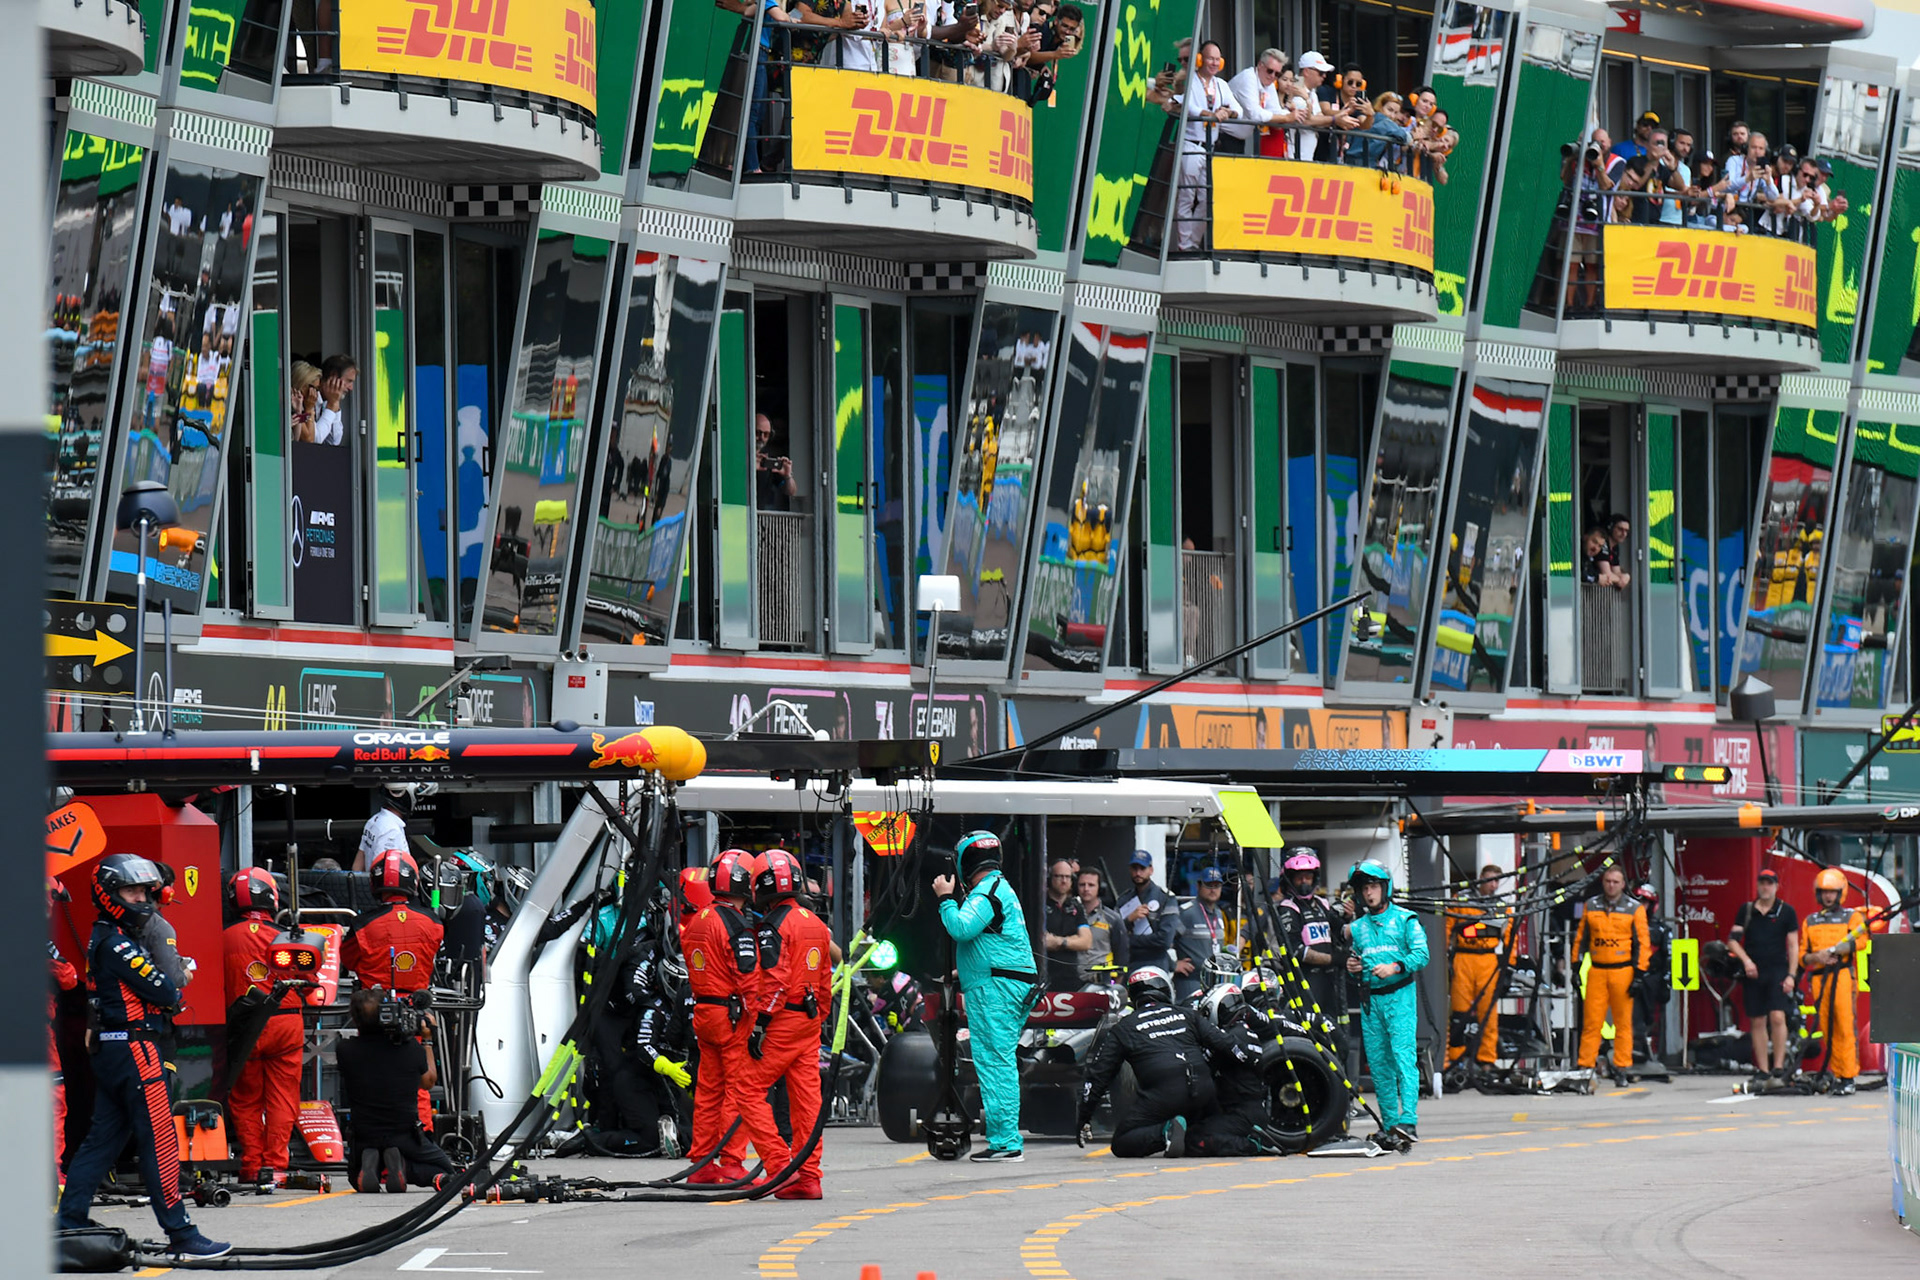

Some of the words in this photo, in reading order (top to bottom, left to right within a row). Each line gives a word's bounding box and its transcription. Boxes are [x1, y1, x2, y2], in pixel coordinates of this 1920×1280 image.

[404, 0, 517, 70] DHL
[850, 87, 952, 166] DHL
[1266, 175, 1359, 242] DHL
[1653, 241, 1743, 301] DHL
[307, 683, 338, 716] LEWIS
[470, 688, 494, 723] ORGE
[172, 708, 203, 724] ETRONAS
[916, 706, 957, 738] ESEBAN
[353, 731, 451, 745] ORACLE
[354, 748, 380, 761] Red
[381, 747, 407, 761] Bull
[1584, 755, 1624, 767] BWT
[354, 765, 451, 774] RACING
[47, 811, 77, 835] AKES
[1135, 1013, 1187, 1032] PETRONAS
